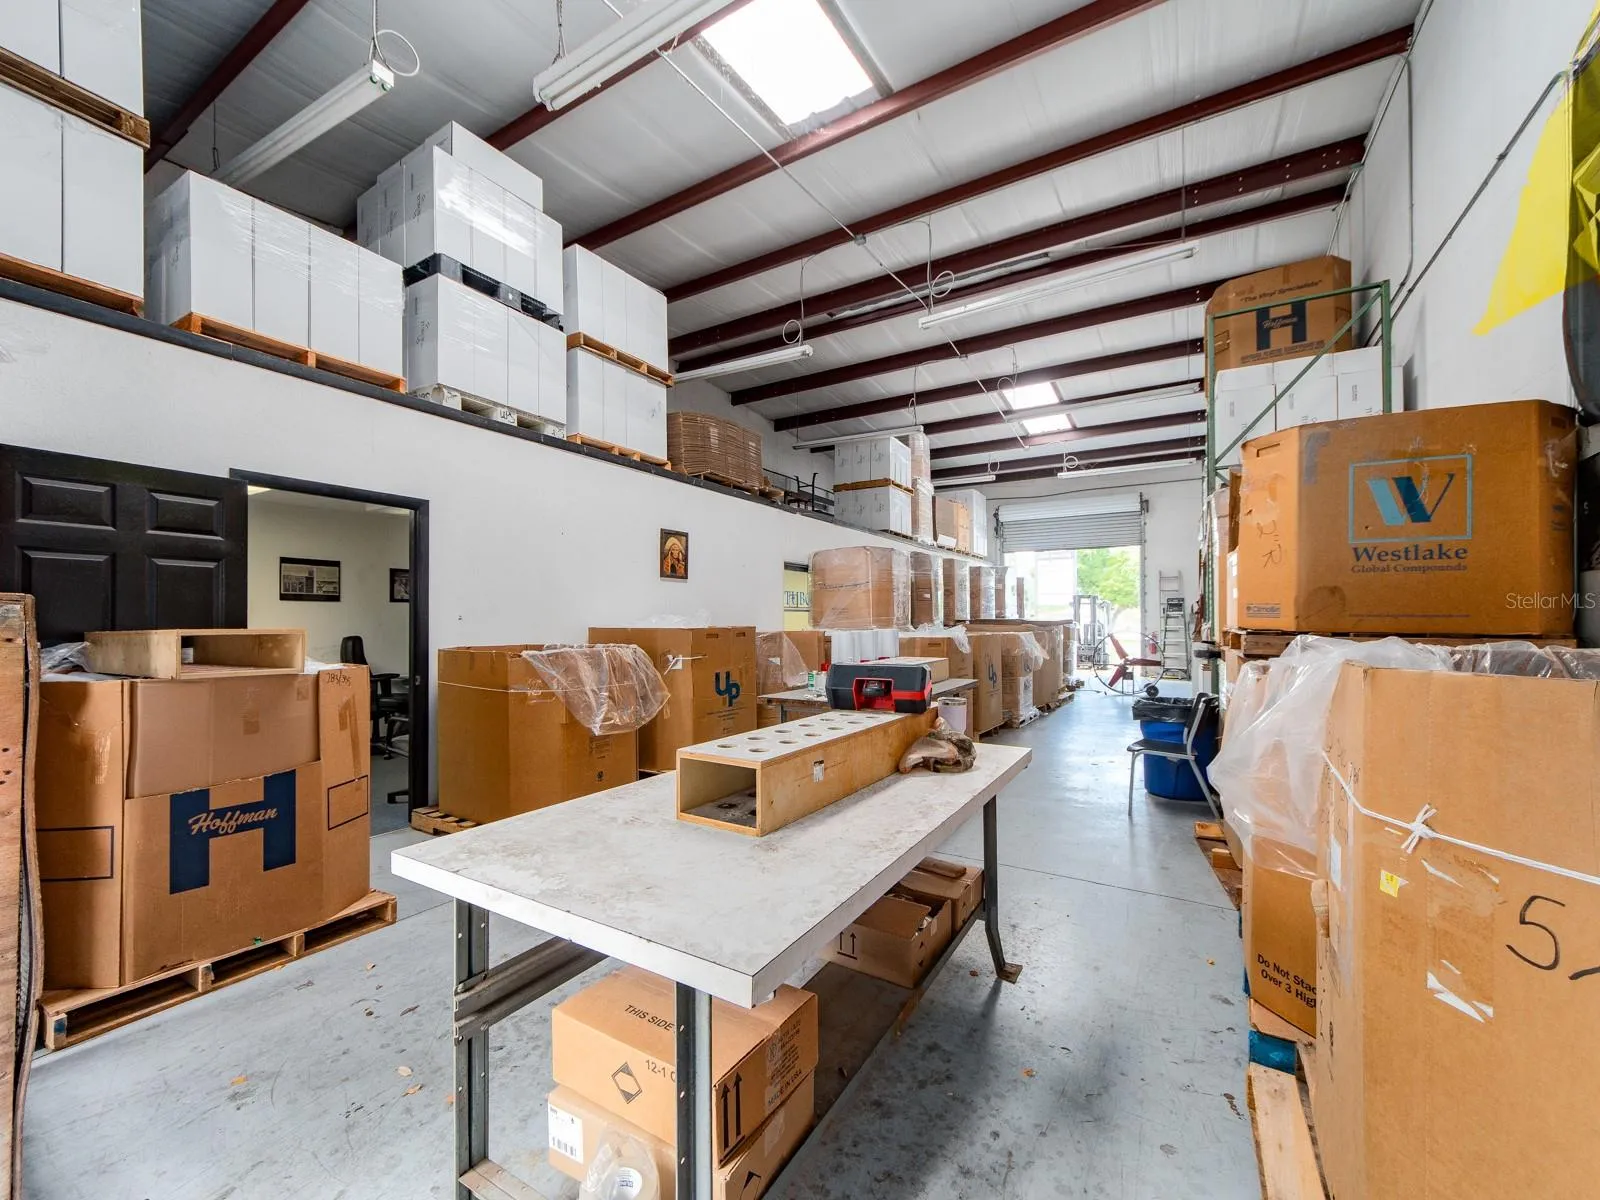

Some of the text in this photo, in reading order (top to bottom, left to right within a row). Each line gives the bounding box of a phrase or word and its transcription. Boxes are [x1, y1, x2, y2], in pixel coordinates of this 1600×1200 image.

[1351, 543, 1469, 562] Westlake
[1351, 562, 1468, 574] Global Compounds
[187, 807, 278, 835] Hoffman
[1257, 953, 1316, 995] Do Not Stac
[1261, 969, 1282, 987] Over
[1285, 983, 1292, 993] 3
[624, 1004, 675, 1031] THIS SIDE
[645, 1059, 666, 1079] 12-1
